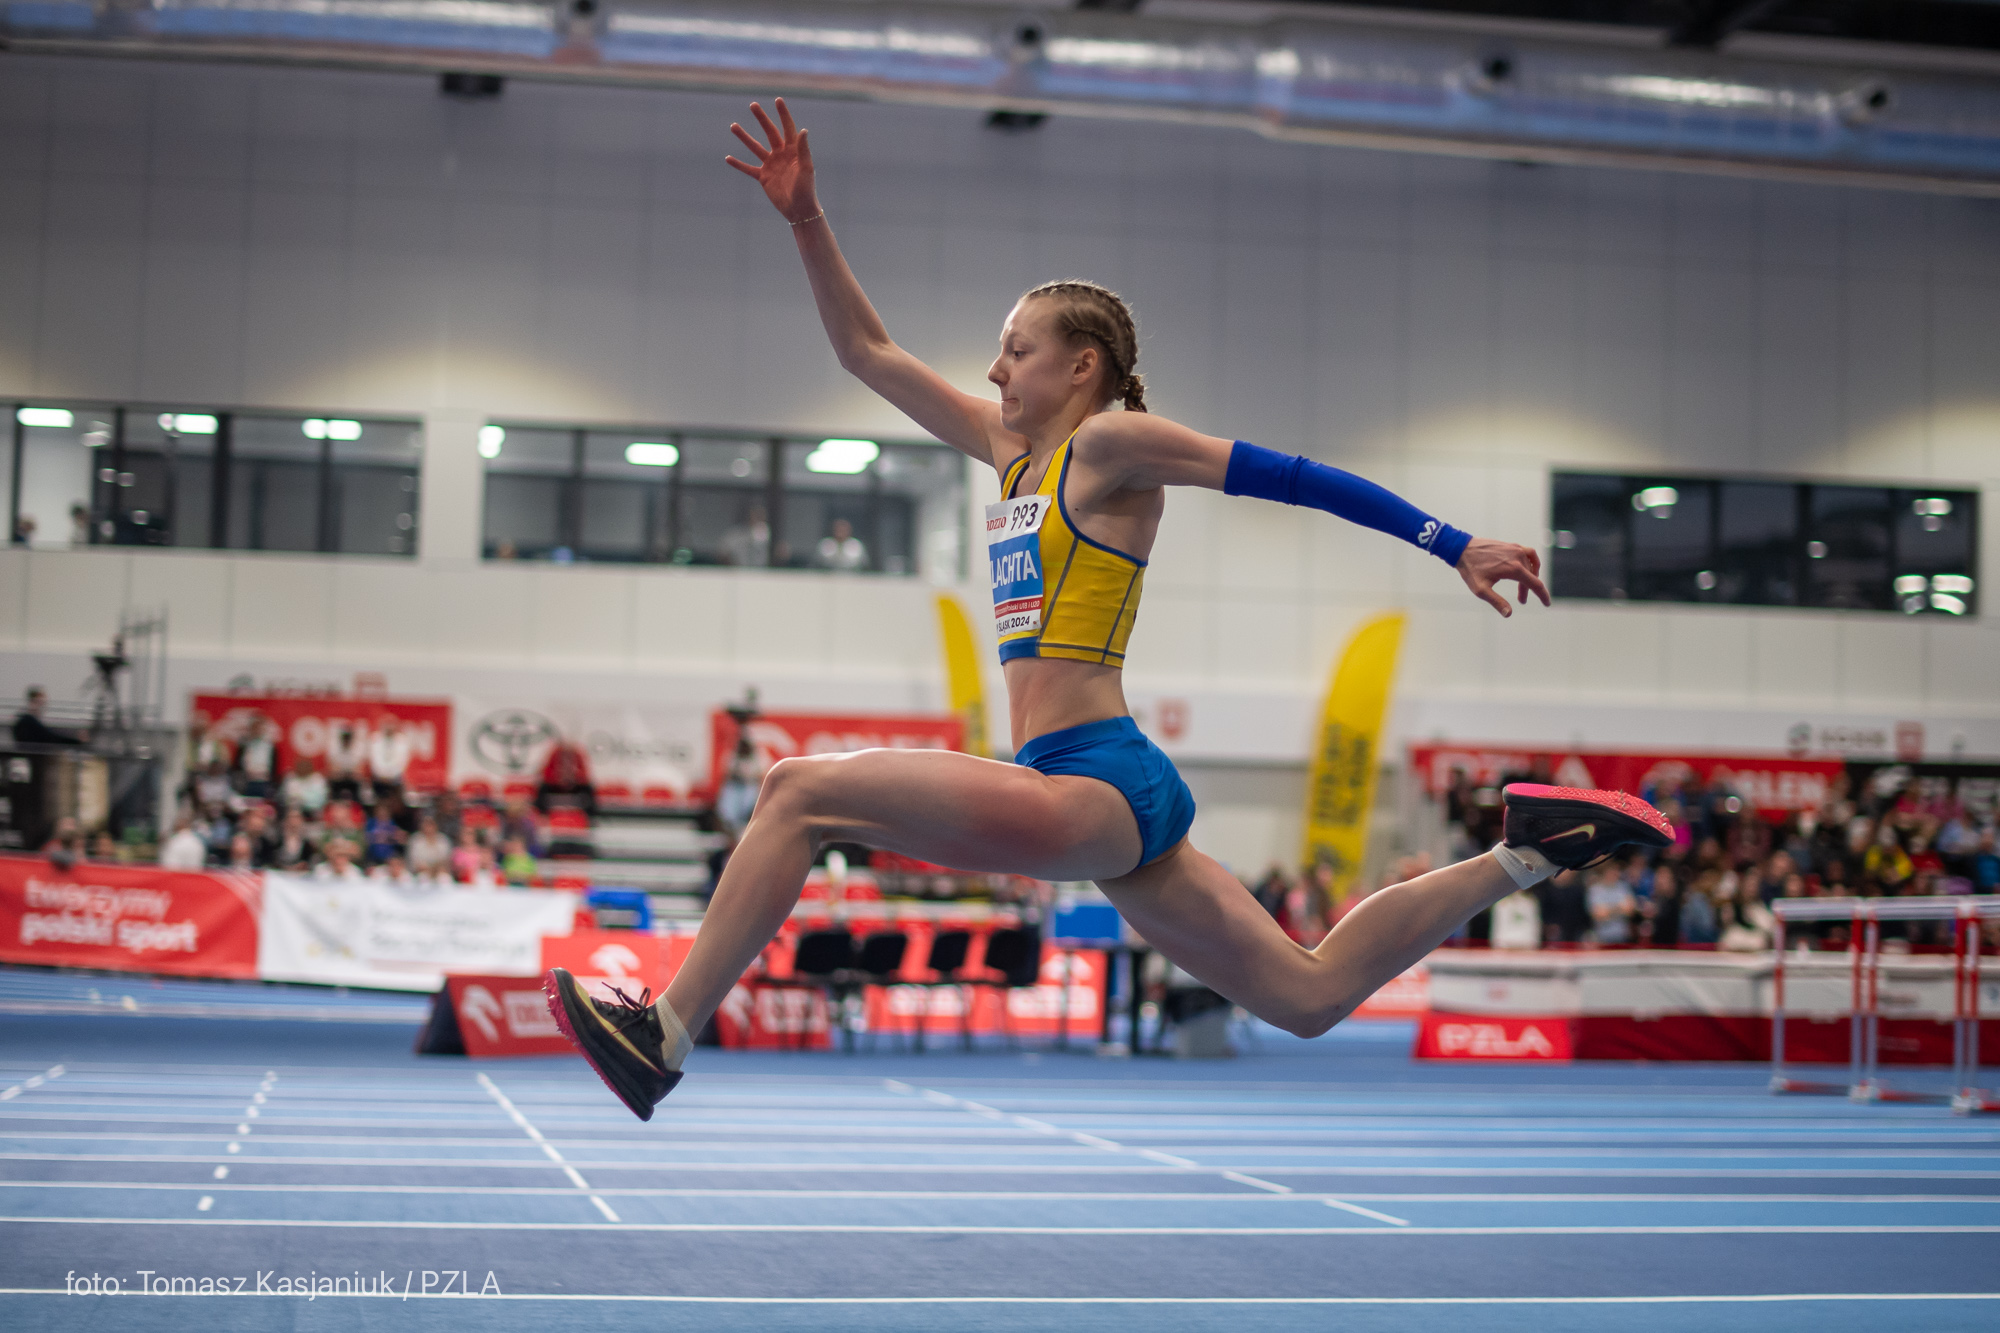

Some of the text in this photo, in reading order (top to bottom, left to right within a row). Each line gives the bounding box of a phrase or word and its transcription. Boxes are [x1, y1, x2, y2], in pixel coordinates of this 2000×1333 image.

[1010, 502, 1039, 531] 993
[1011, 615, 1030, 629] 2024
[1437, 1022, 1554, 1058] PZLA
